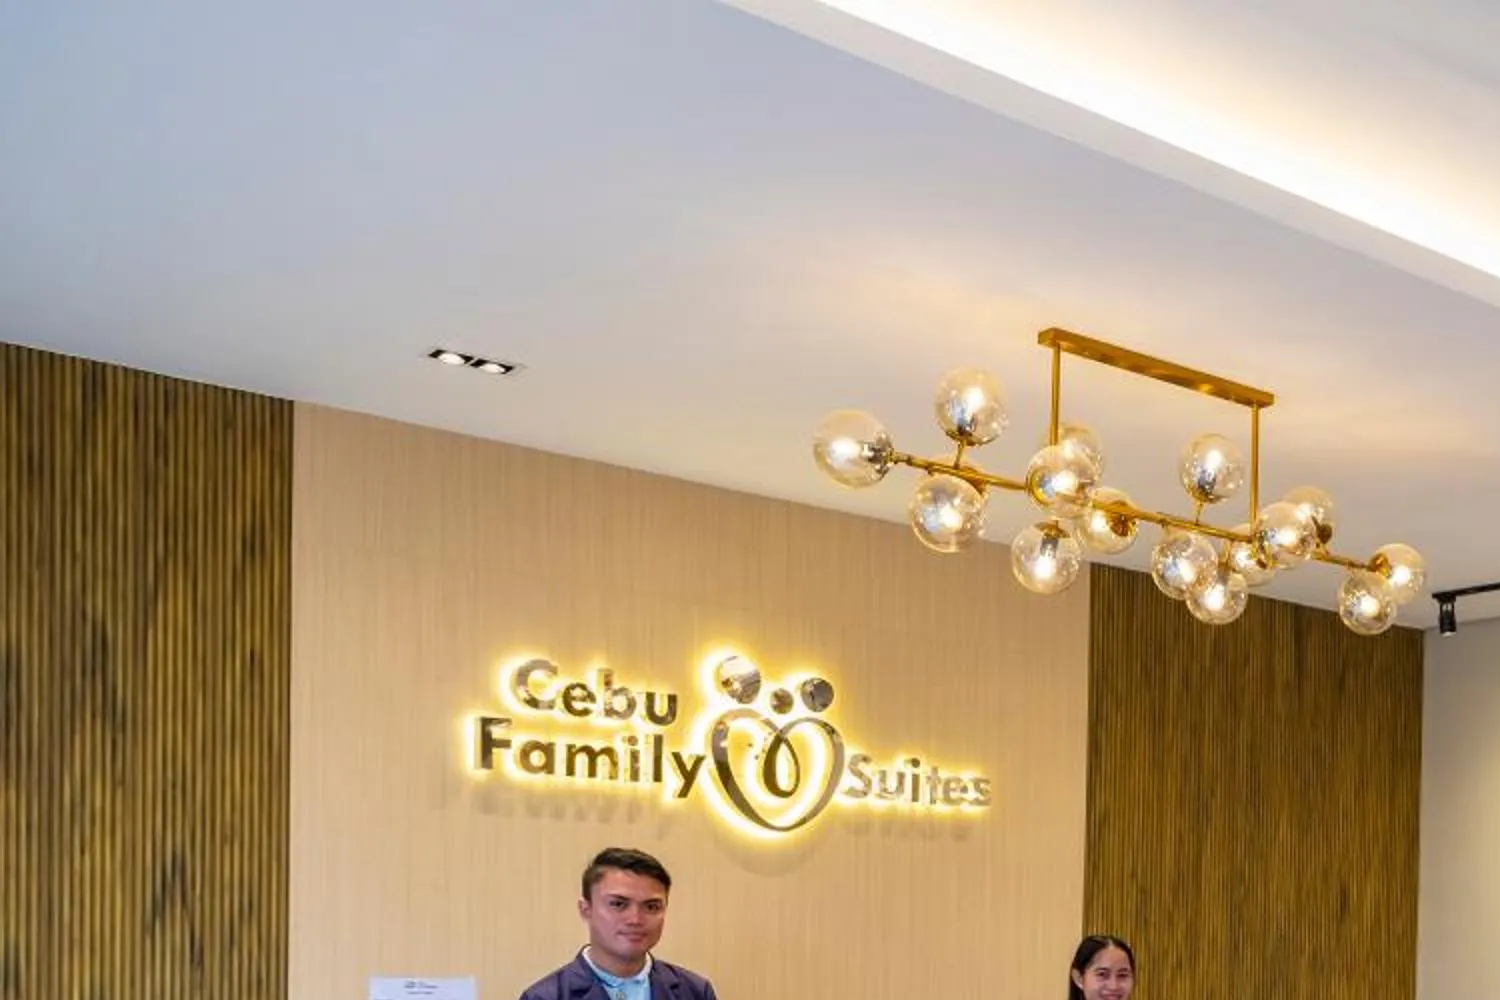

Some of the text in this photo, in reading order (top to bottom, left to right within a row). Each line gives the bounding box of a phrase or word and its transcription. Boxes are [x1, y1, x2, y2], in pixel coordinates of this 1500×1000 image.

[511, 659, 678, 726] Cebu
[475, 716, 992, 807] Family Suites
